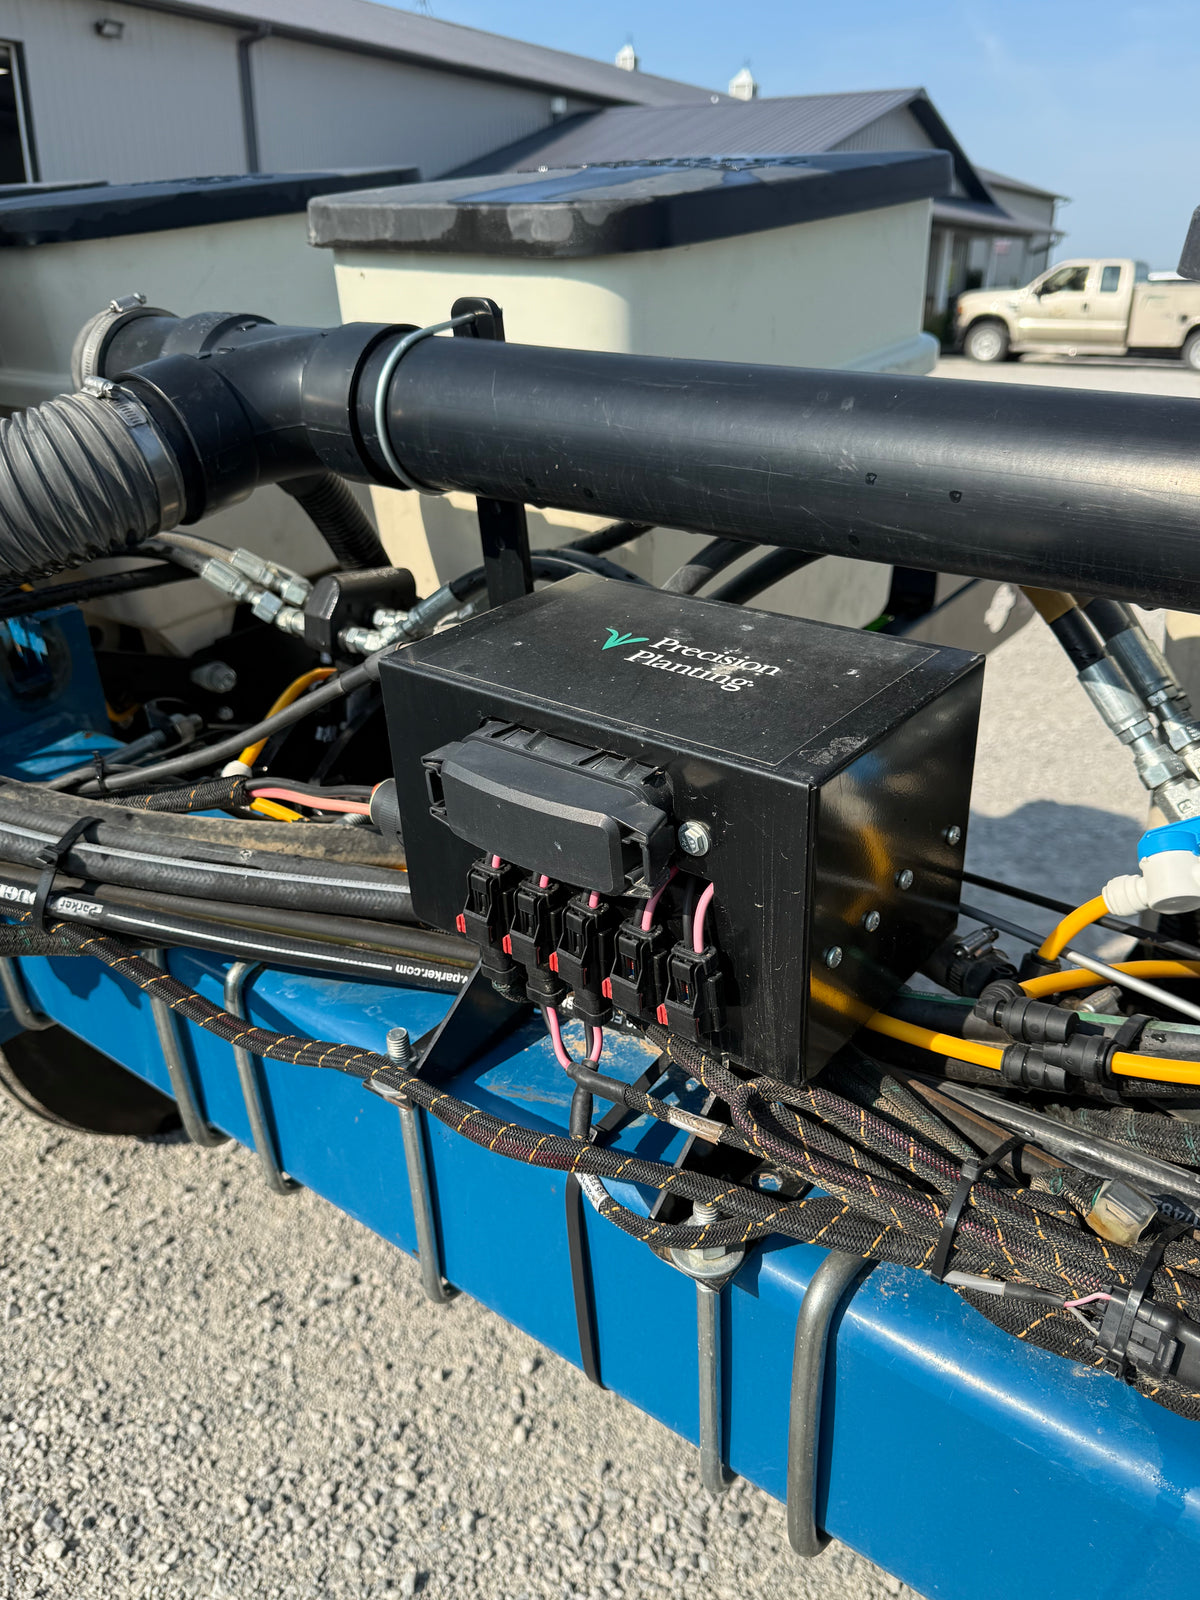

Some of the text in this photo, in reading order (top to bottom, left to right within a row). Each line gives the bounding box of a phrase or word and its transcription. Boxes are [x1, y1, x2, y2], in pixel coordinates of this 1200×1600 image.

[623, 649, 753, 692] Planting
[648, 636, 781, 677] Precision
[59, 898, 99, 917] Parker
